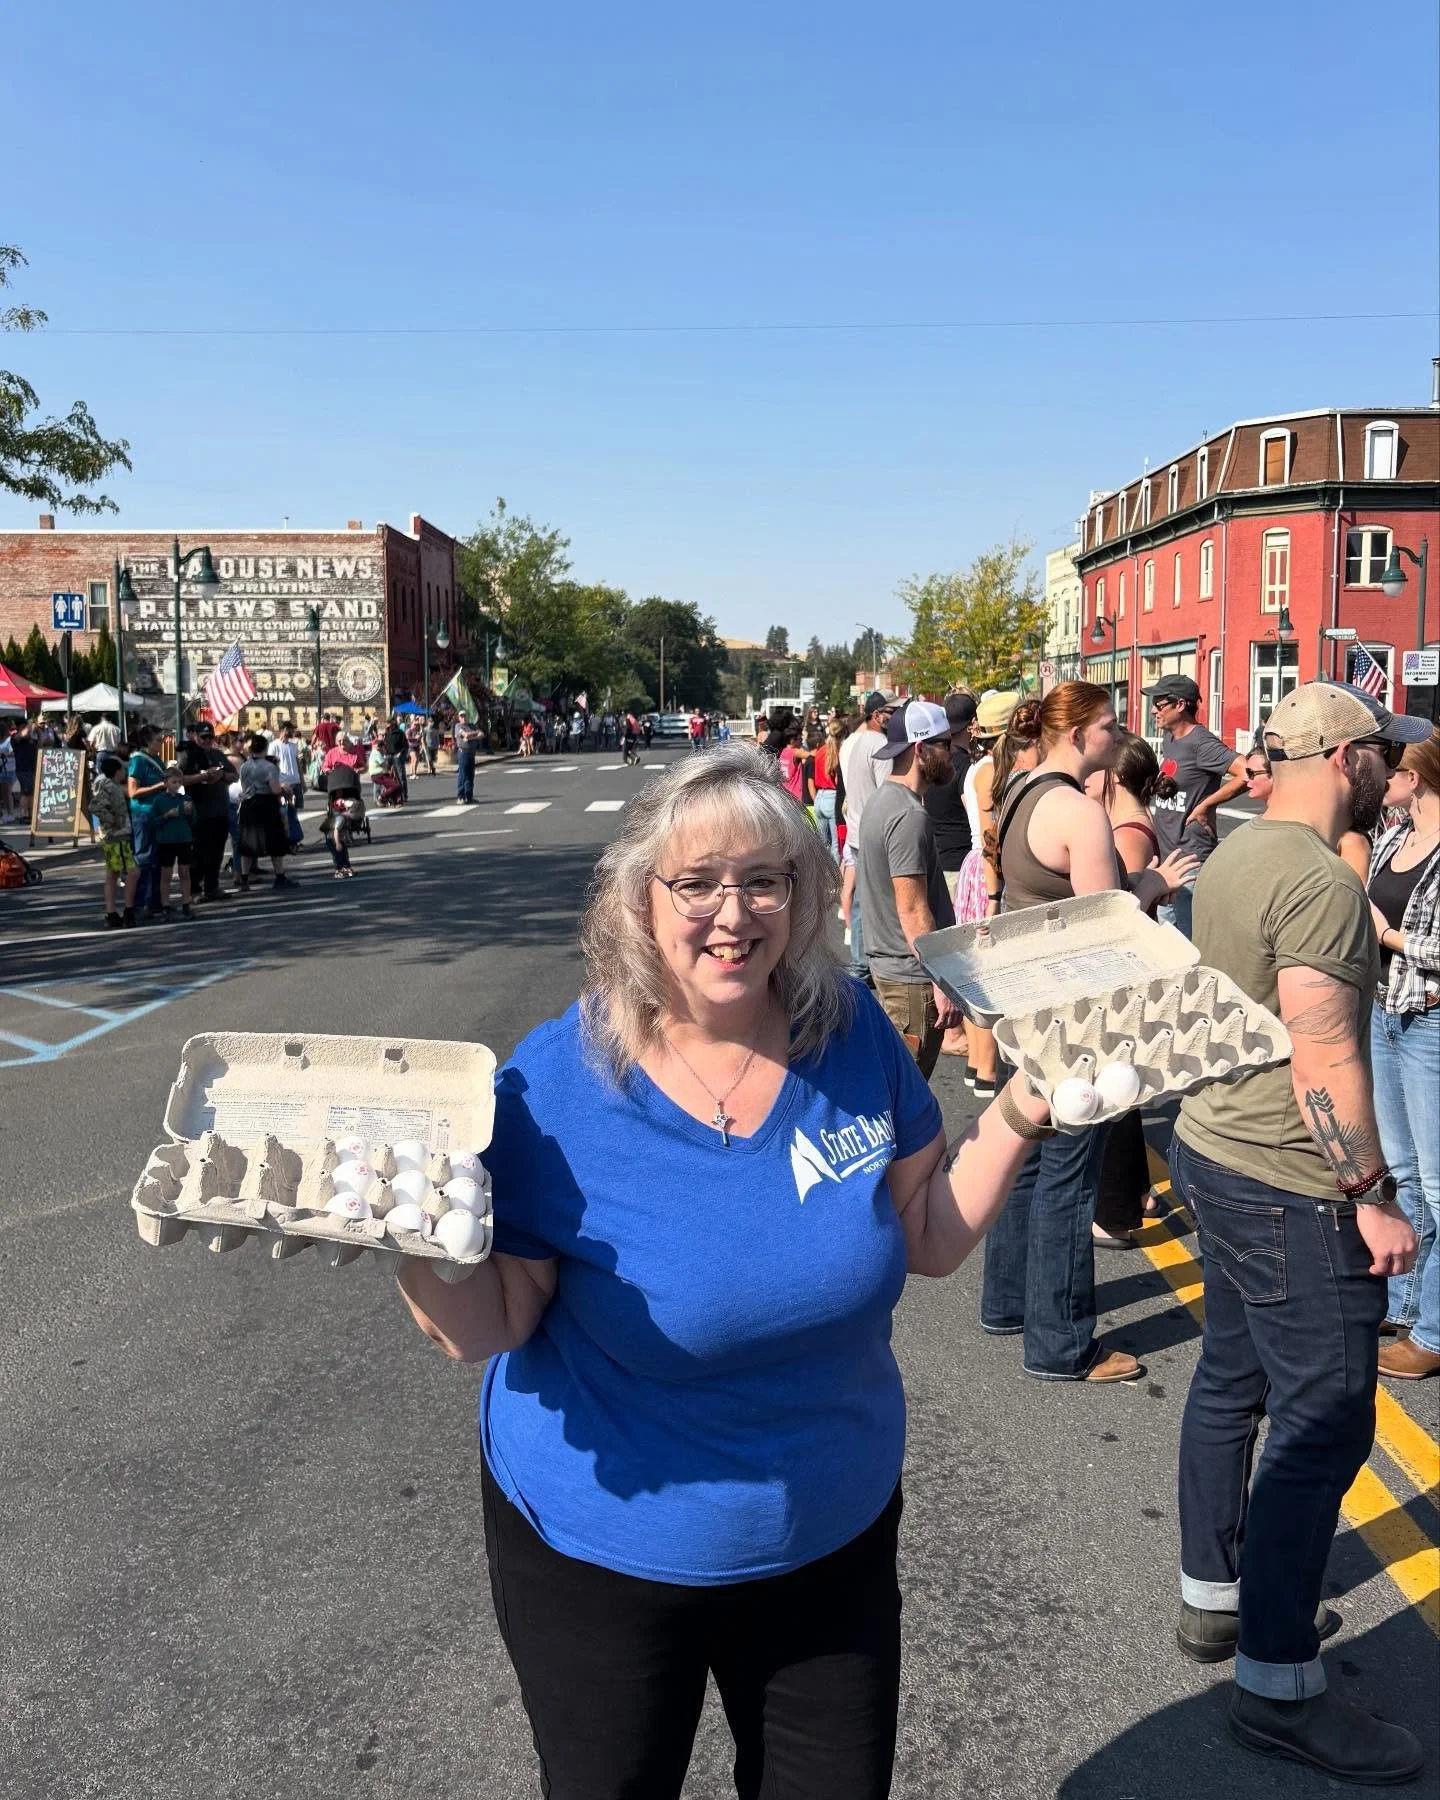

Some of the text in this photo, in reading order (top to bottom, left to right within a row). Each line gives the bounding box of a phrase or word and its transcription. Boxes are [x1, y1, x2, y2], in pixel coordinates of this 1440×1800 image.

[131, 563, 159, 574] THE
[231, 582, 321, 594] PRINTING
[198, 600, 278, 618] NEWS
[913, 730, 930, 738] Trex
[820, 1125, 867, 1166] STATE
